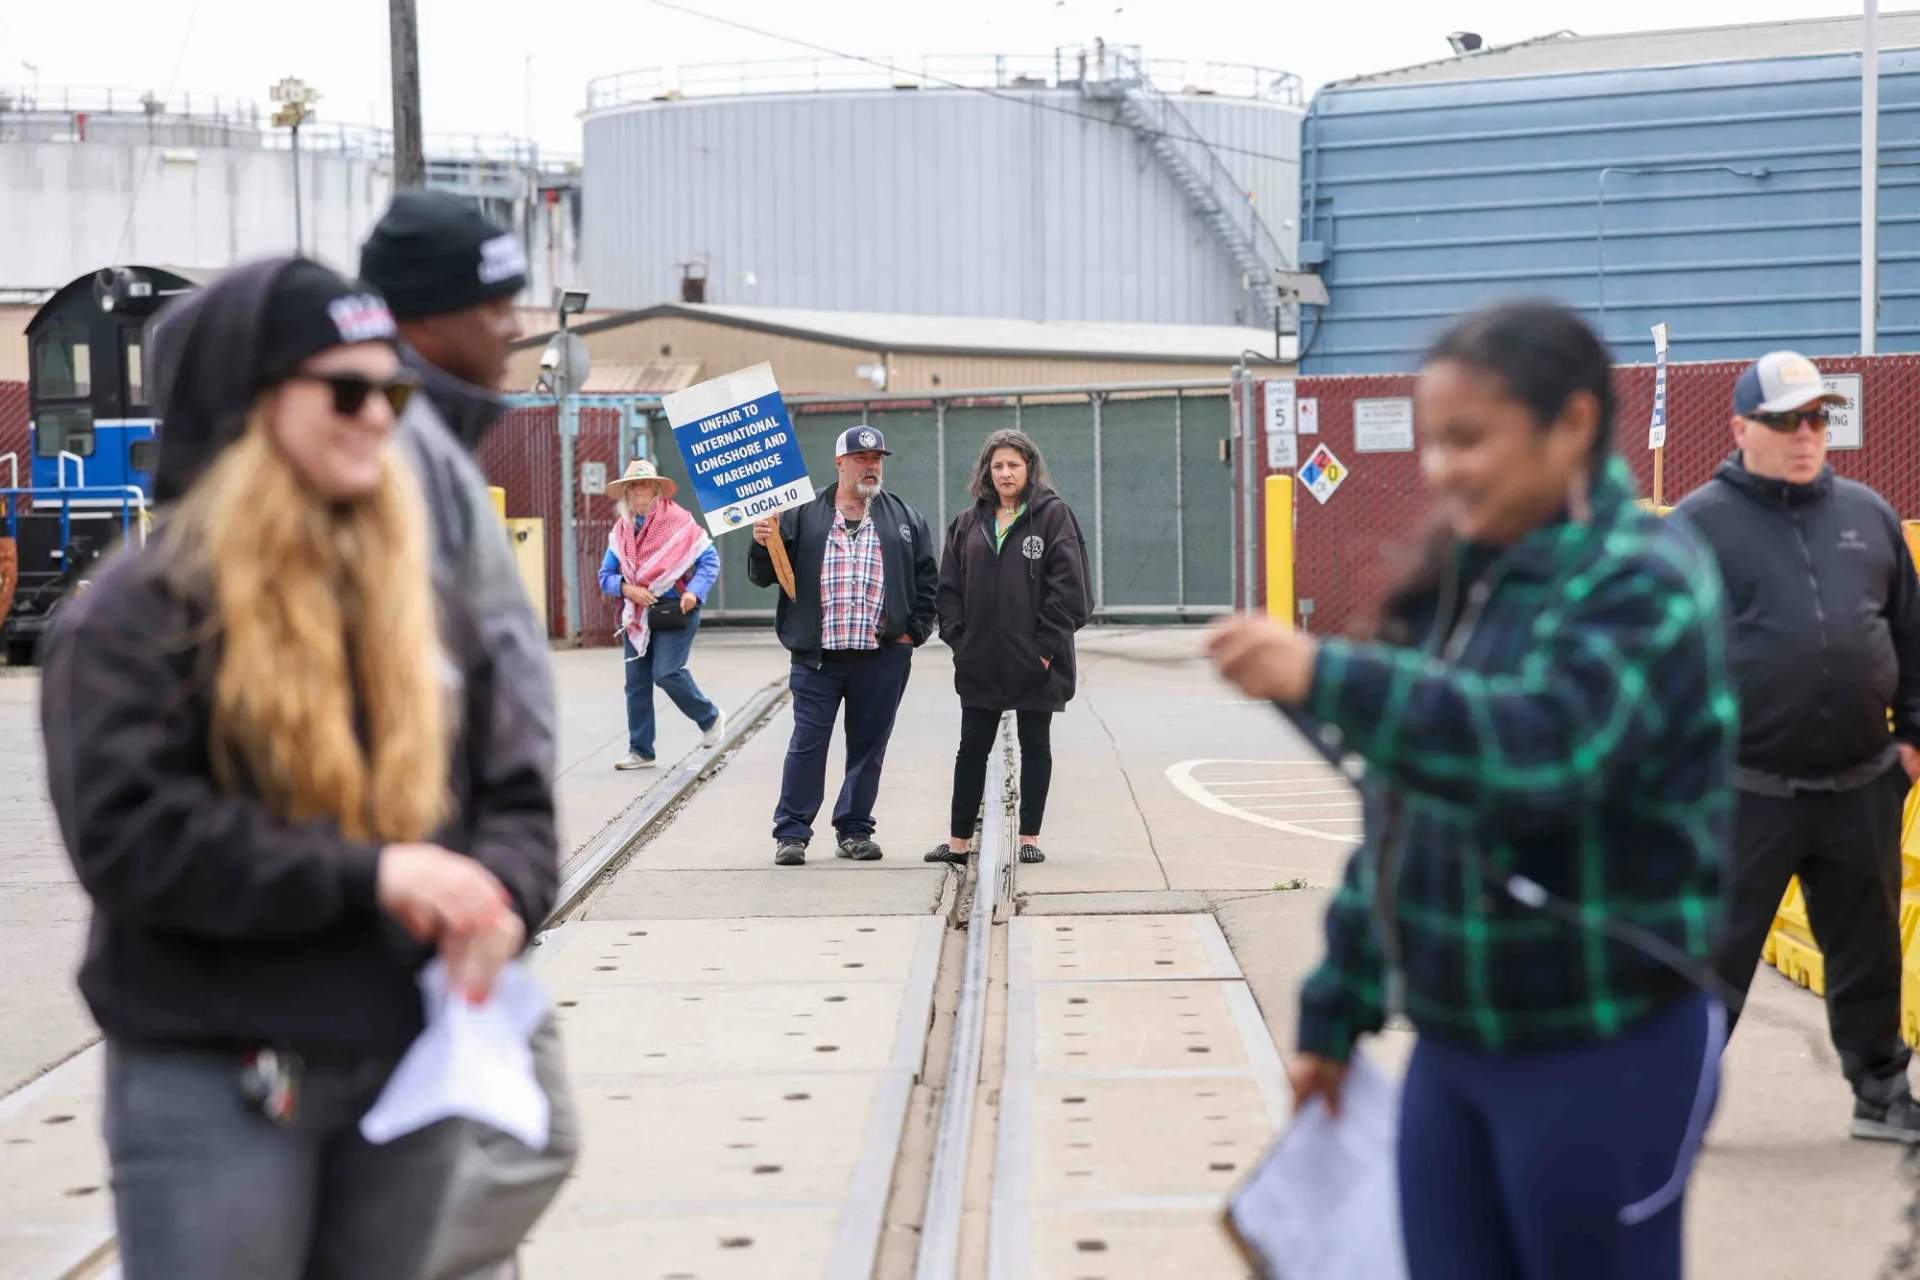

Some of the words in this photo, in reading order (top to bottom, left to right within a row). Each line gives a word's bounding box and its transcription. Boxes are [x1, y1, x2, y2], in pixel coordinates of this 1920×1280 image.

[699, 410, 742, 433] UNFAIR
[742, 403, 759, 418] TO
[1275, 408, 1286, 427] 5
[690, 416, 780, 456] INTERNATIONAL
[694, 441, 763, 475] LONGSHORE
[764, 432, 787, 450] AND
[712, 453, 783, 487] WAREHOUSE
[1305, 465, 1314, 485] 1
[1328, 465, 1338, 482] 0
[735, 475, 773, 498] UNION
[744, 495, 783, 517] LOCAL
[784, 488, 798, 502] 10
